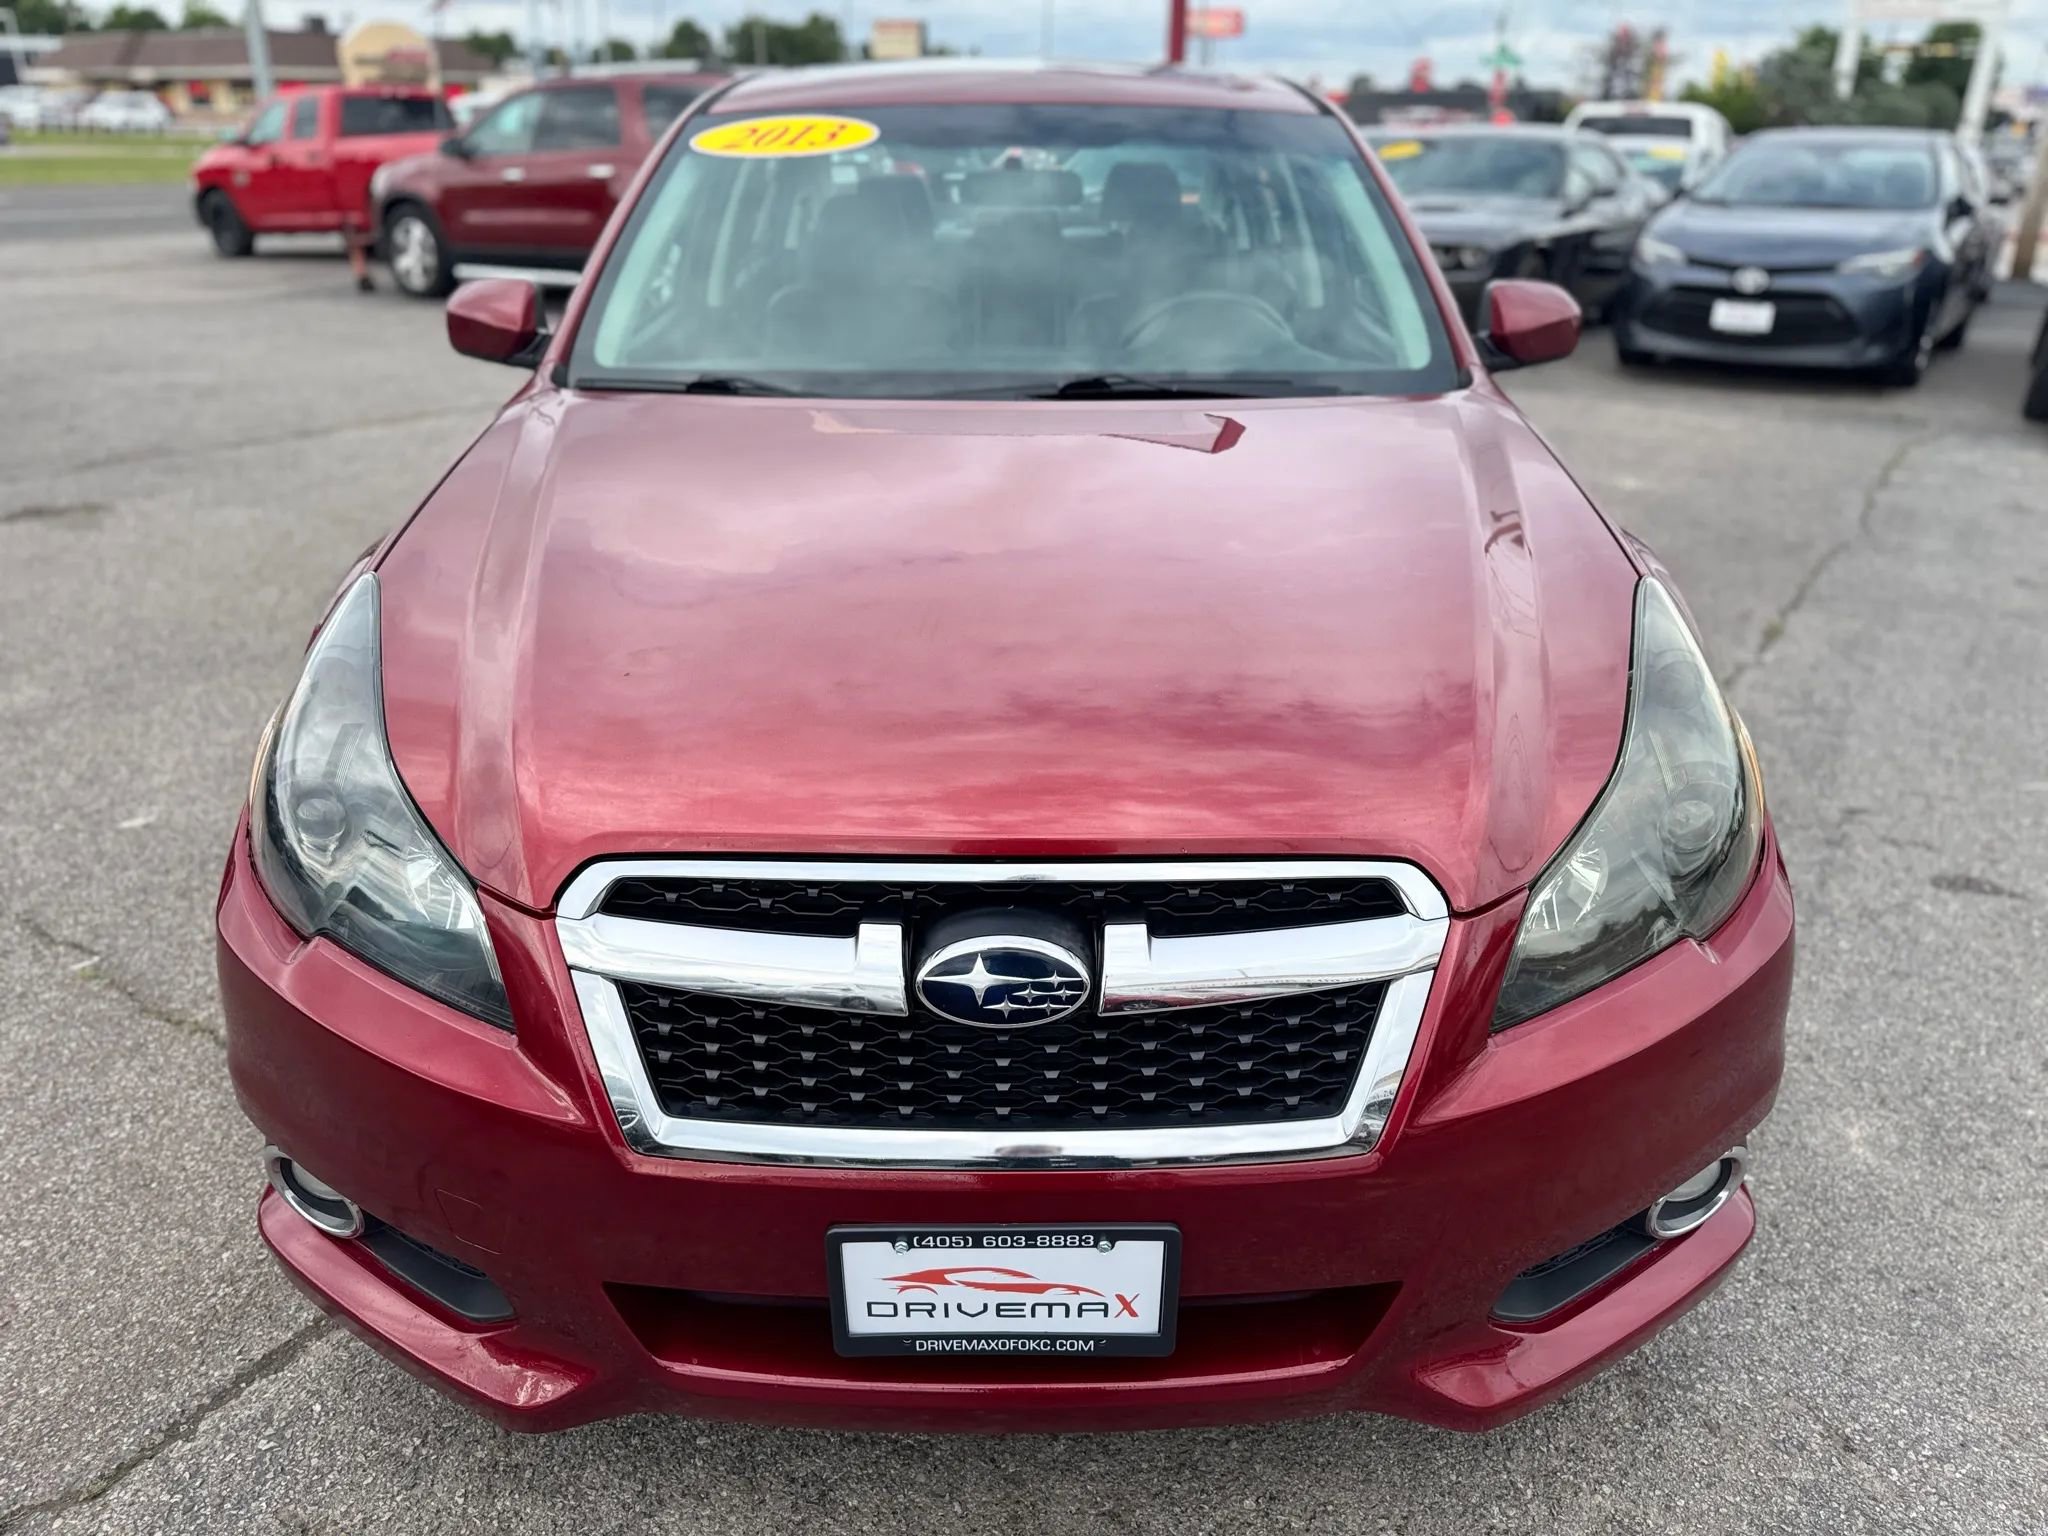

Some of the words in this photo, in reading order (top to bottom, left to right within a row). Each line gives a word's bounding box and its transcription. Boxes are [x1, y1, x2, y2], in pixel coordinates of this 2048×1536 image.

[722, 123, 848, 150] 2013
[913, 1235, 973, 1248] (405)
[982, 1234, 1095, 1248] 603-8883
[866, 1293, 1140, 1319] DRIVEMAX
[915, 1338, 1095, 1352] DRIVEMAXOFOKC.COM
